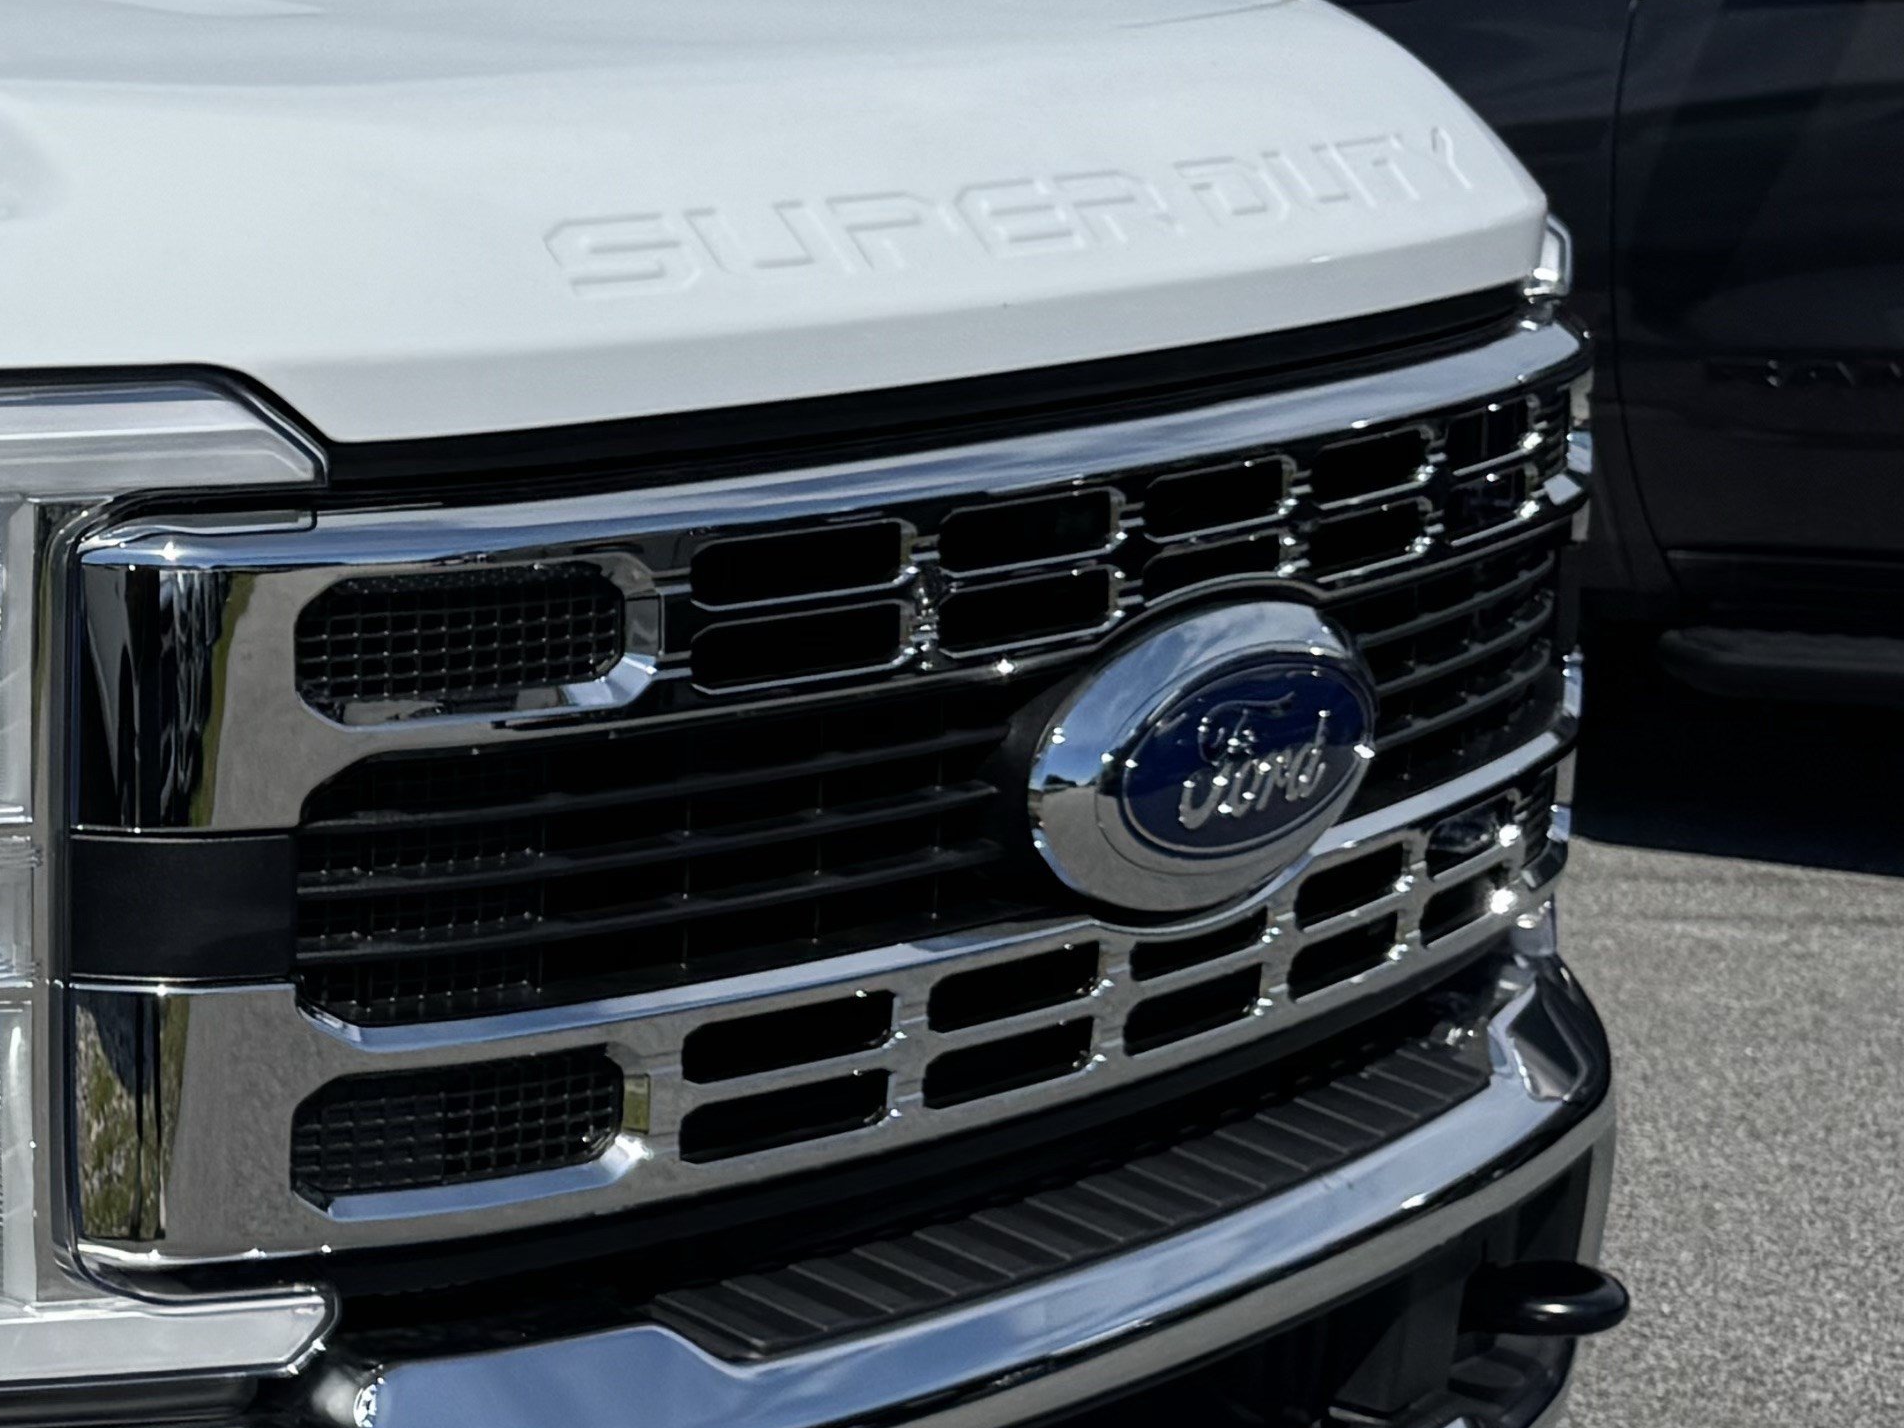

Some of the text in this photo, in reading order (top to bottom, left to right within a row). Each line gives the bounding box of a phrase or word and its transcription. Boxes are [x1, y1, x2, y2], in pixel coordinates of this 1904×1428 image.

[542, 125, 1475, 300] SUPER DUTY
[1178, 690, 1330, 829] Ford
